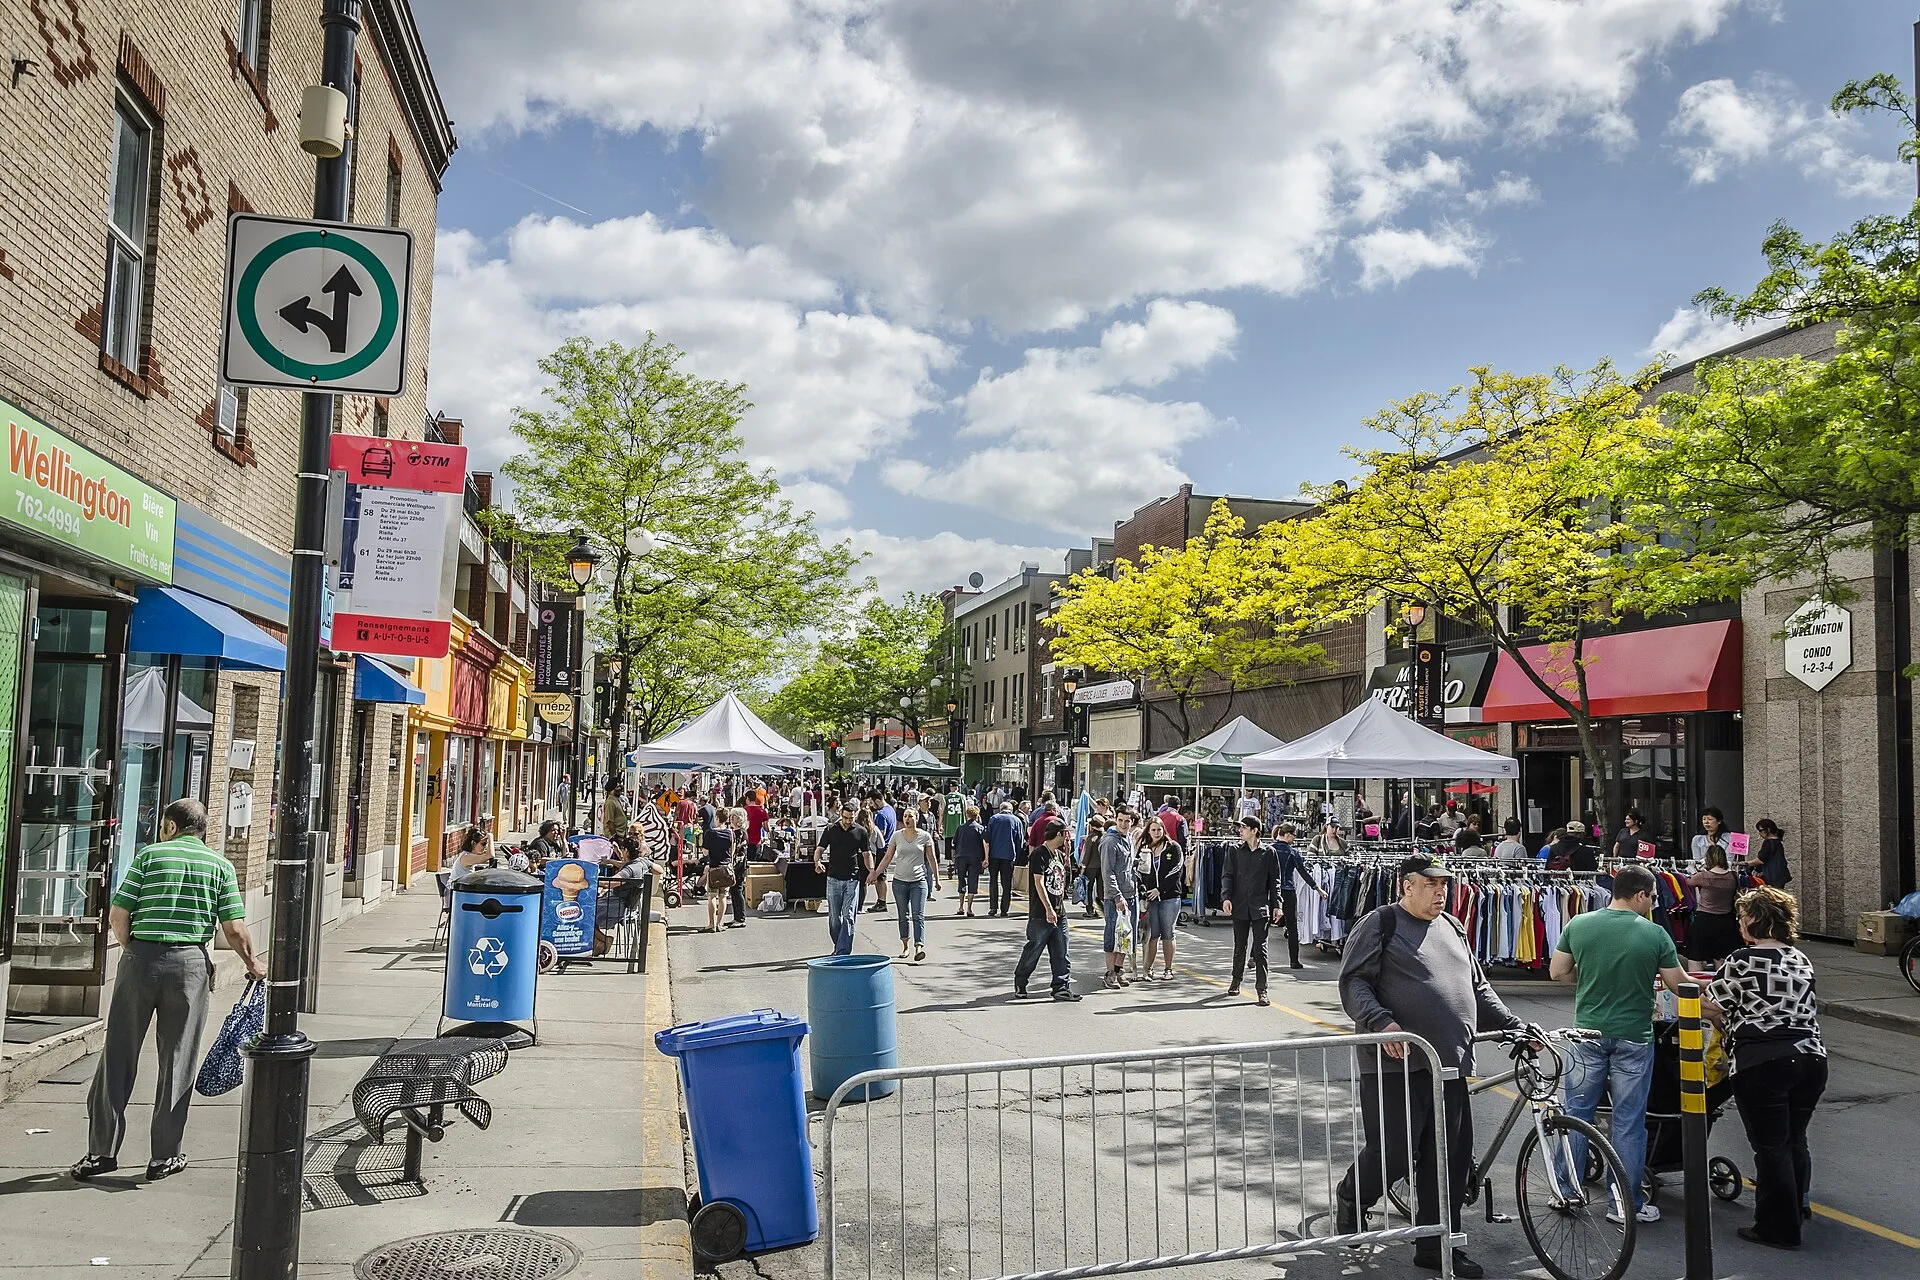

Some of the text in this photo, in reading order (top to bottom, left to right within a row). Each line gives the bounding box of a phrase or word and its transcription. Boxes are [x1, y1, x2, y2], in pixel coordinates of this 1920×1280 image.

[422, 456, 450, 467] STM
[8, 420, 132, 528] Wellington
[142, 493, 164, 518] Bière
[16, 490, 81, 537] 762-4994
[145, 521, 158, 542] Vin
[130, 544, 171, 576] Fruits de mer
[358, 621, 430, 633] Renseignements
[374, 632, 429, 644] A-U-T-O-B-U-S
[1803, 646, 1832, 658] CONDO
[538, 635, 546, 685] NOUVEAUTÉS
[1802, 661, 1834, 674] 1-2-3-4
[1154, 767, 1176, 780] SÉCURITÉ
[948, 804, 962, 815] 34
